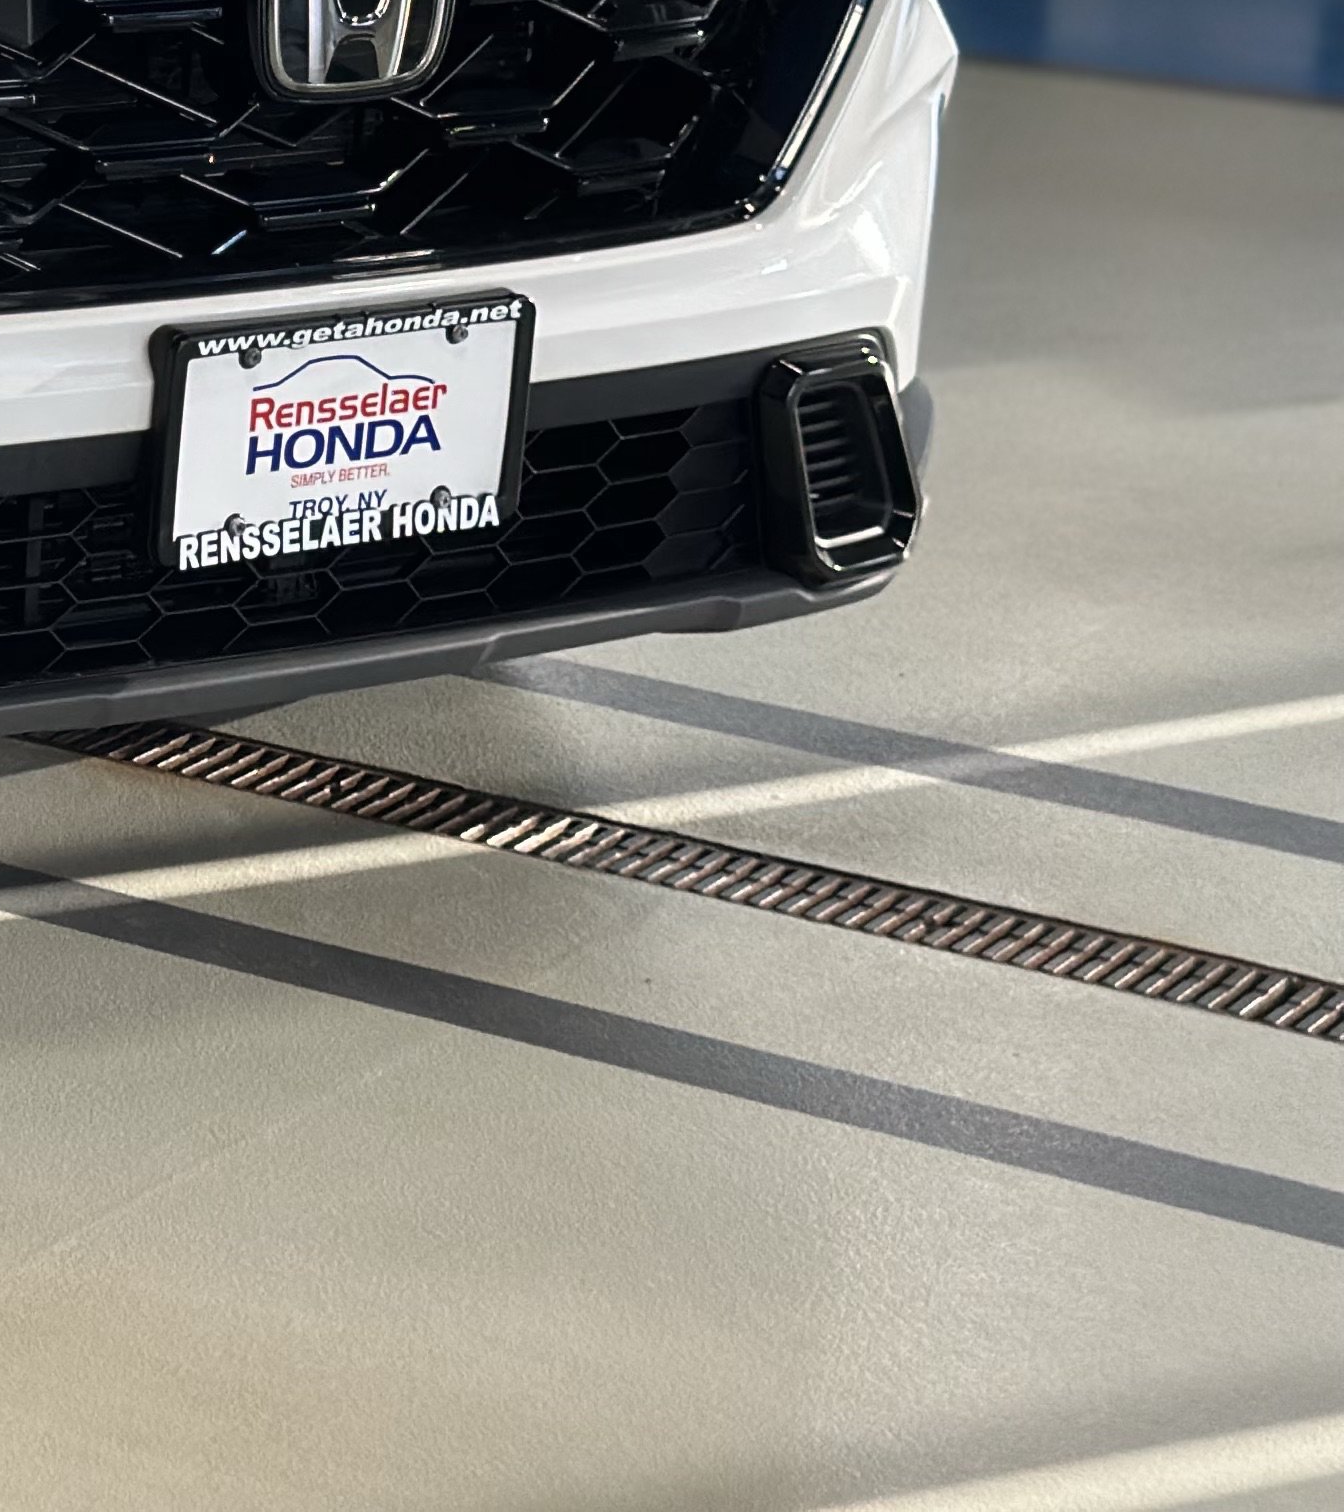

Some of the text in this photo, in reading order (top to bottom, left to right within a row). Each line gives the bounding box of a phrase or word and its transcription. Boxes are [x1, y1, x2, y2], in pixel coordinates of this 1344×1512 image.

[197, 300, 523, 356] www.getahonda.net
[248, 382, 448, 432] Rensselaer
[245, 414, 442, 475] HONDA
[291, 470, 336, 488] SIMPLY
[358, 489, 387, 510] NY
[179, 495, 500, 571] RENSSELAER HONDA
